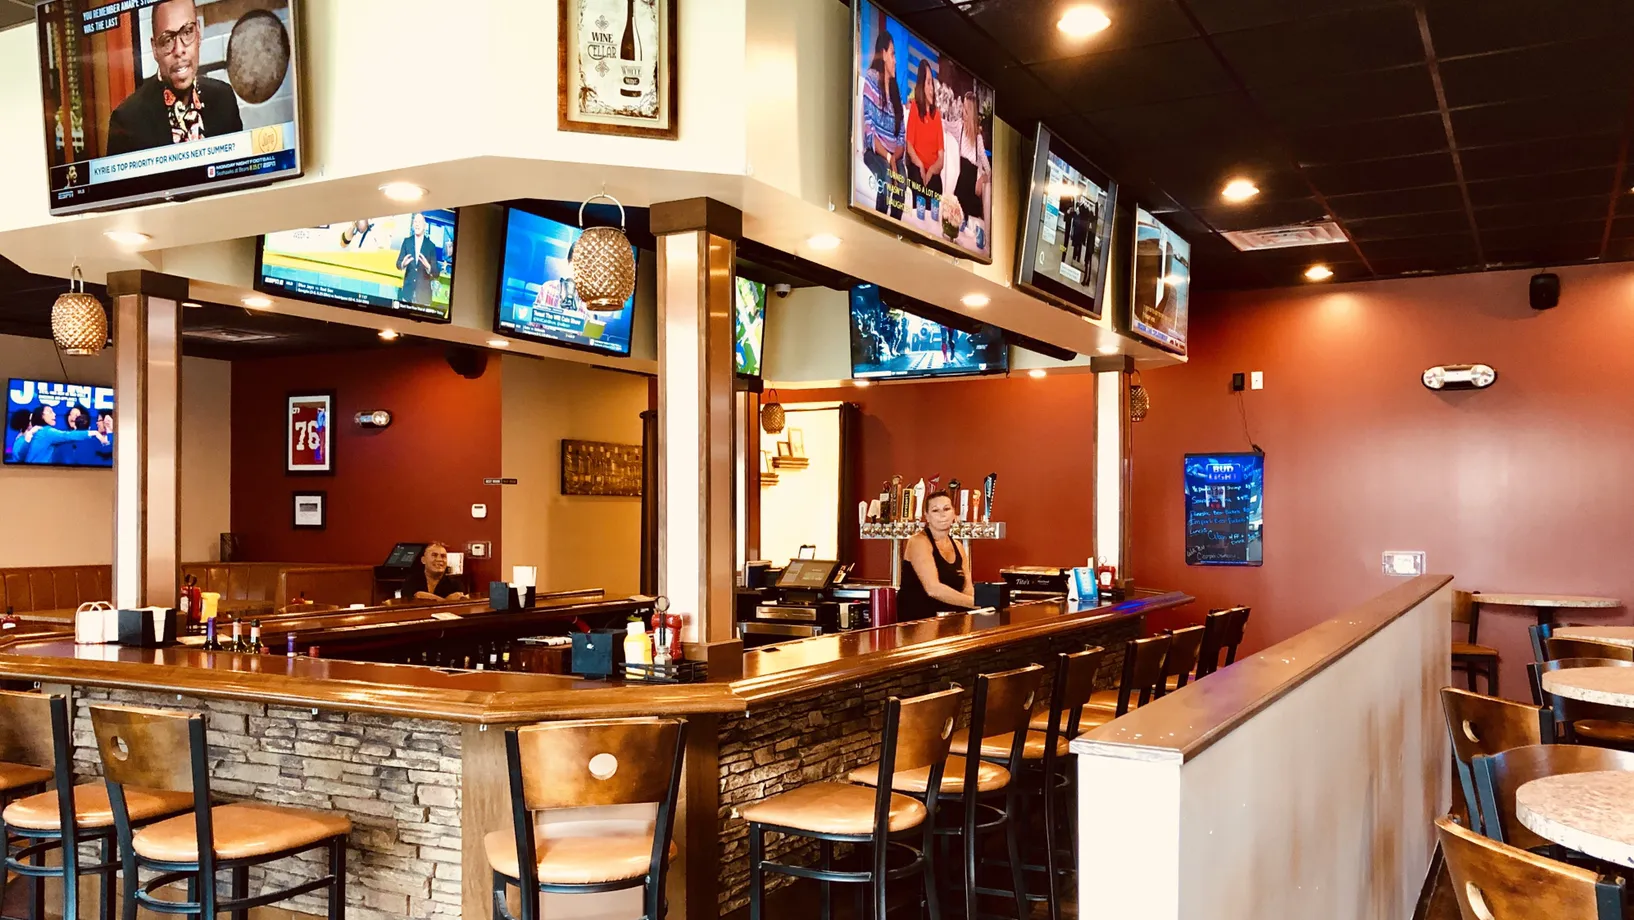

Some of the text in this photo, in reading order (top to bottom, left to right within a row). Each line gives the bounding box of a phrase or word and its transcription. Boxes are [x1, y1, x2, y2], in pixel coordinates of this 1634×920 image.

[92, 4, 120, 18] REMEMBER
[83, 17, 118, 34] WAS THE LAST
[591, 32, 613, 43] WINE
[587, 44, 617, 60] CELLAR
[94, 143, 236, 175] KYRIE IS TOP PRIORITY FOR KNICKS NEXT SUMMER?
[250, 156, 275, 164] FOOTBALL
[10, 380, 113, 410] JUNE
[295, 420, 320, 451] 76
[1213, 465, 1234, 473] BUD
